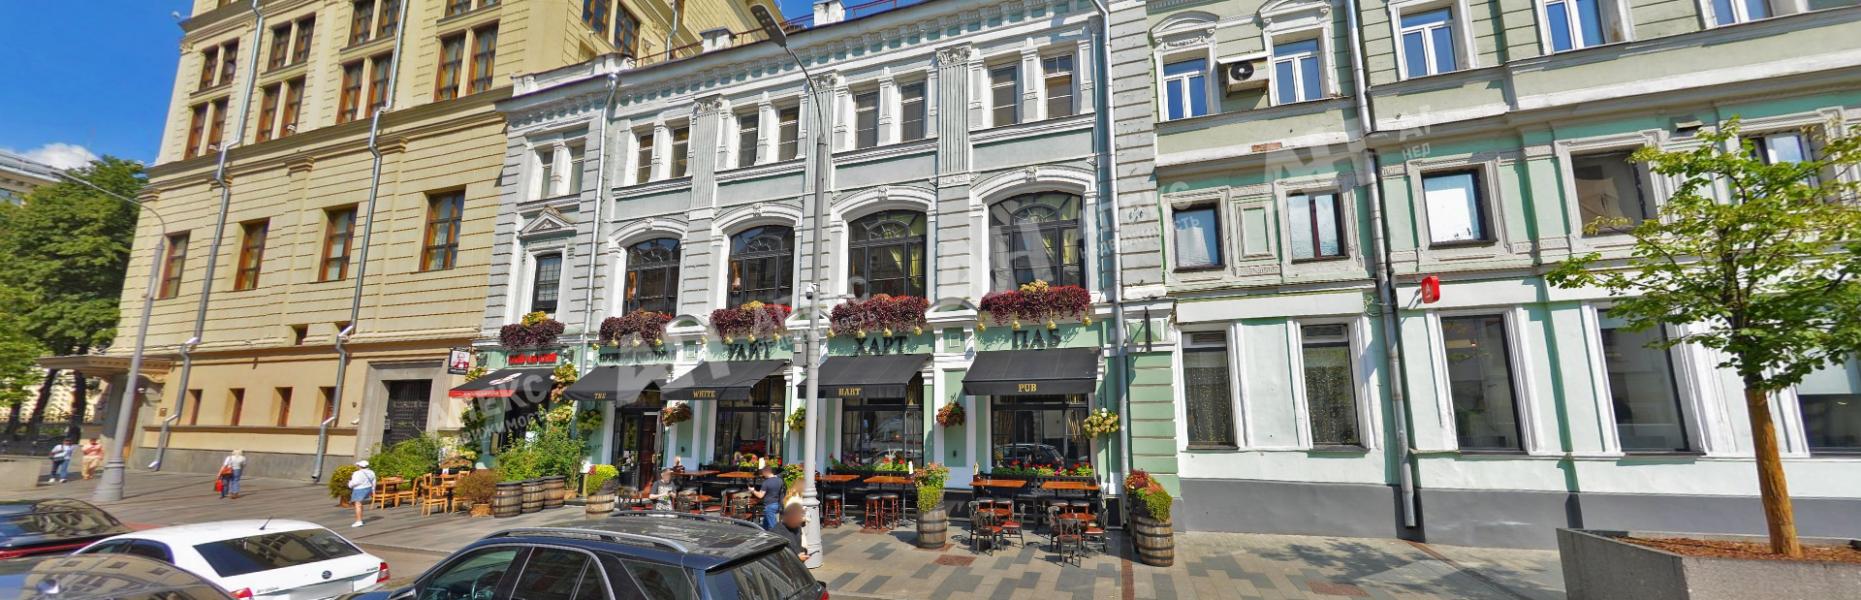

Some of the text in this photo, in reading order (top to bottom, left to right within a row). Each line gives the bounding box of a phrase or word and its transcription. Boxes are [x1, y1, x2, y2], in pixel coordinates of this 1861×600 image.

[855, 336, 907, 356] ХАРТ
[1012, 328, 1061, 350] ПАБ
[692, 389, 716, 399] WHITE
[838, 387, 862, 397] HART
[1018, 383, 1037, 393] PUB
